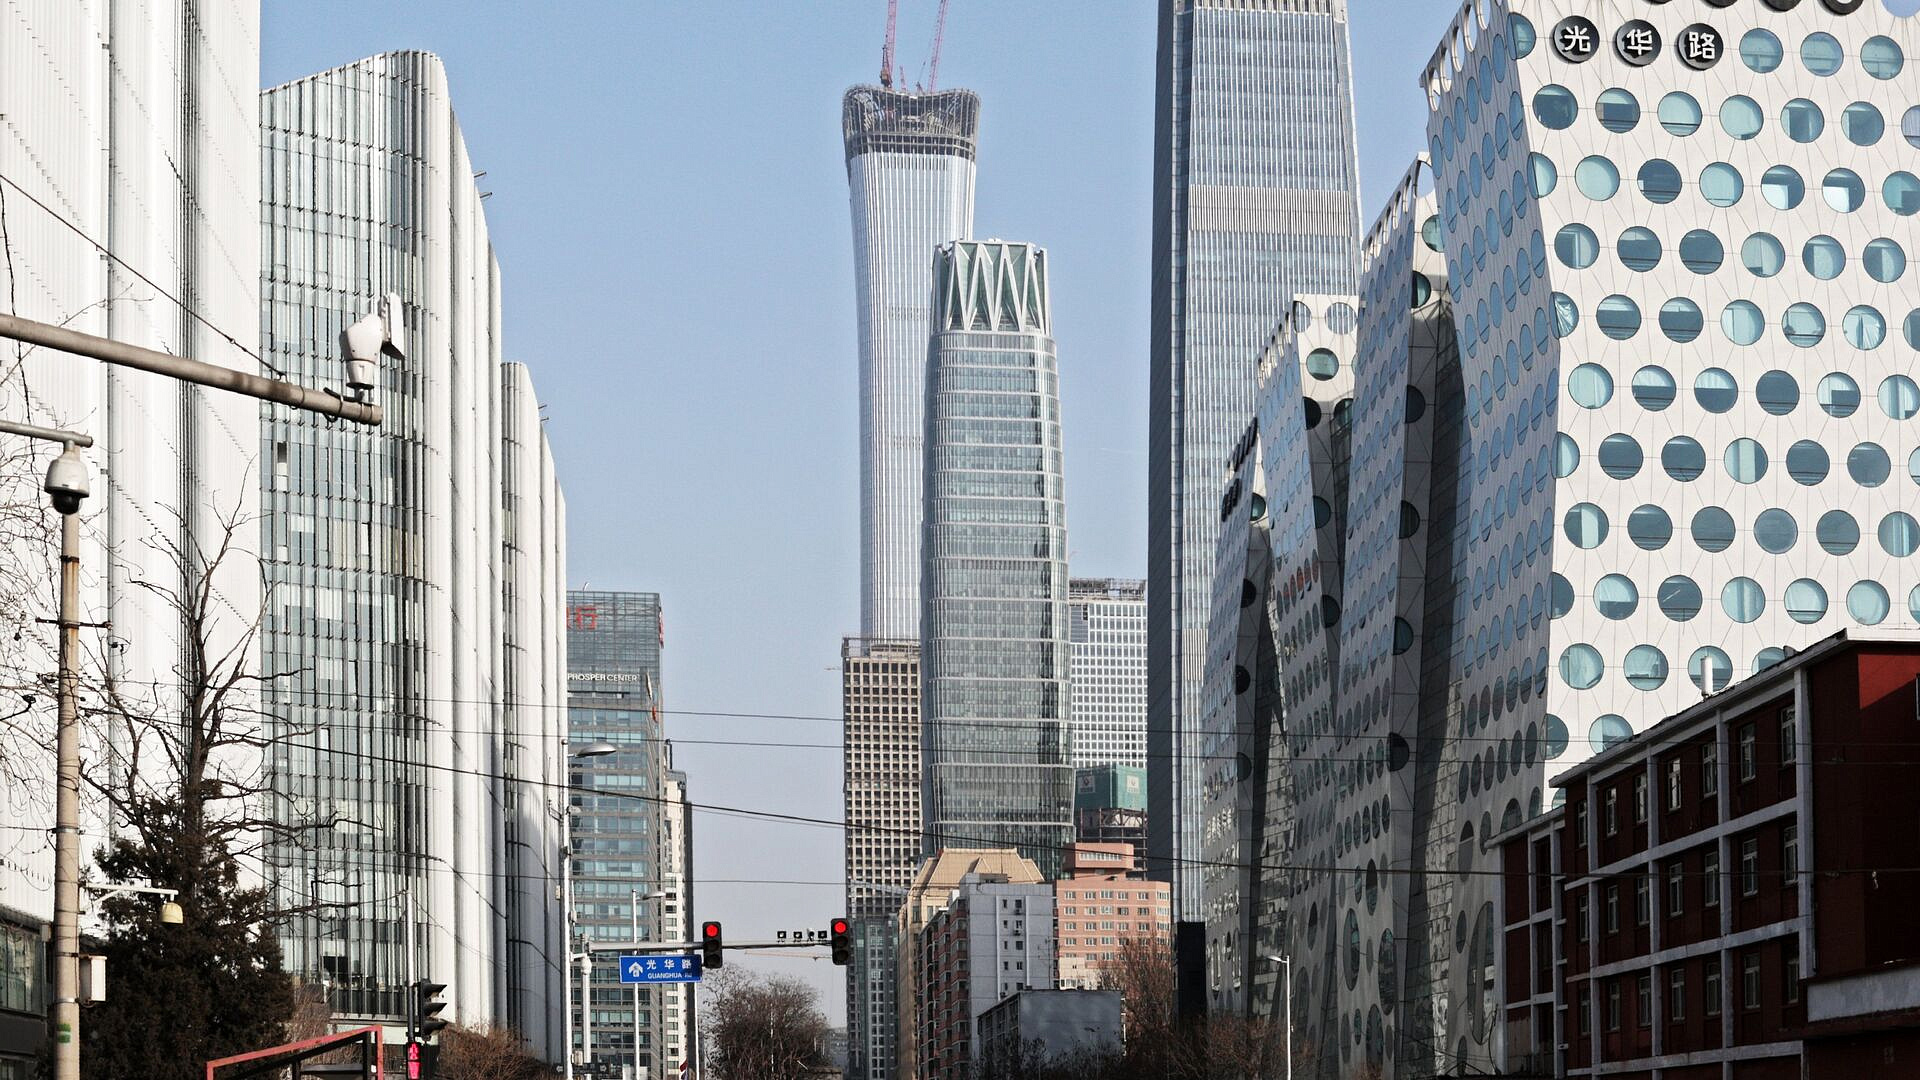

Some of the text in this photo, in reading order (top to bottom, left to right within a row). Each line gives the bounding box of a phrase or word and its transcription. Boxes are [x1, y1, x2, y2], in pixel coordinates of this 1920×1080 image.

[1563, 25, 1716, 60] 光华路
[567, 672, 638, 682] PROSPER CENTER
[646, 959, 692, 970] 光华路
